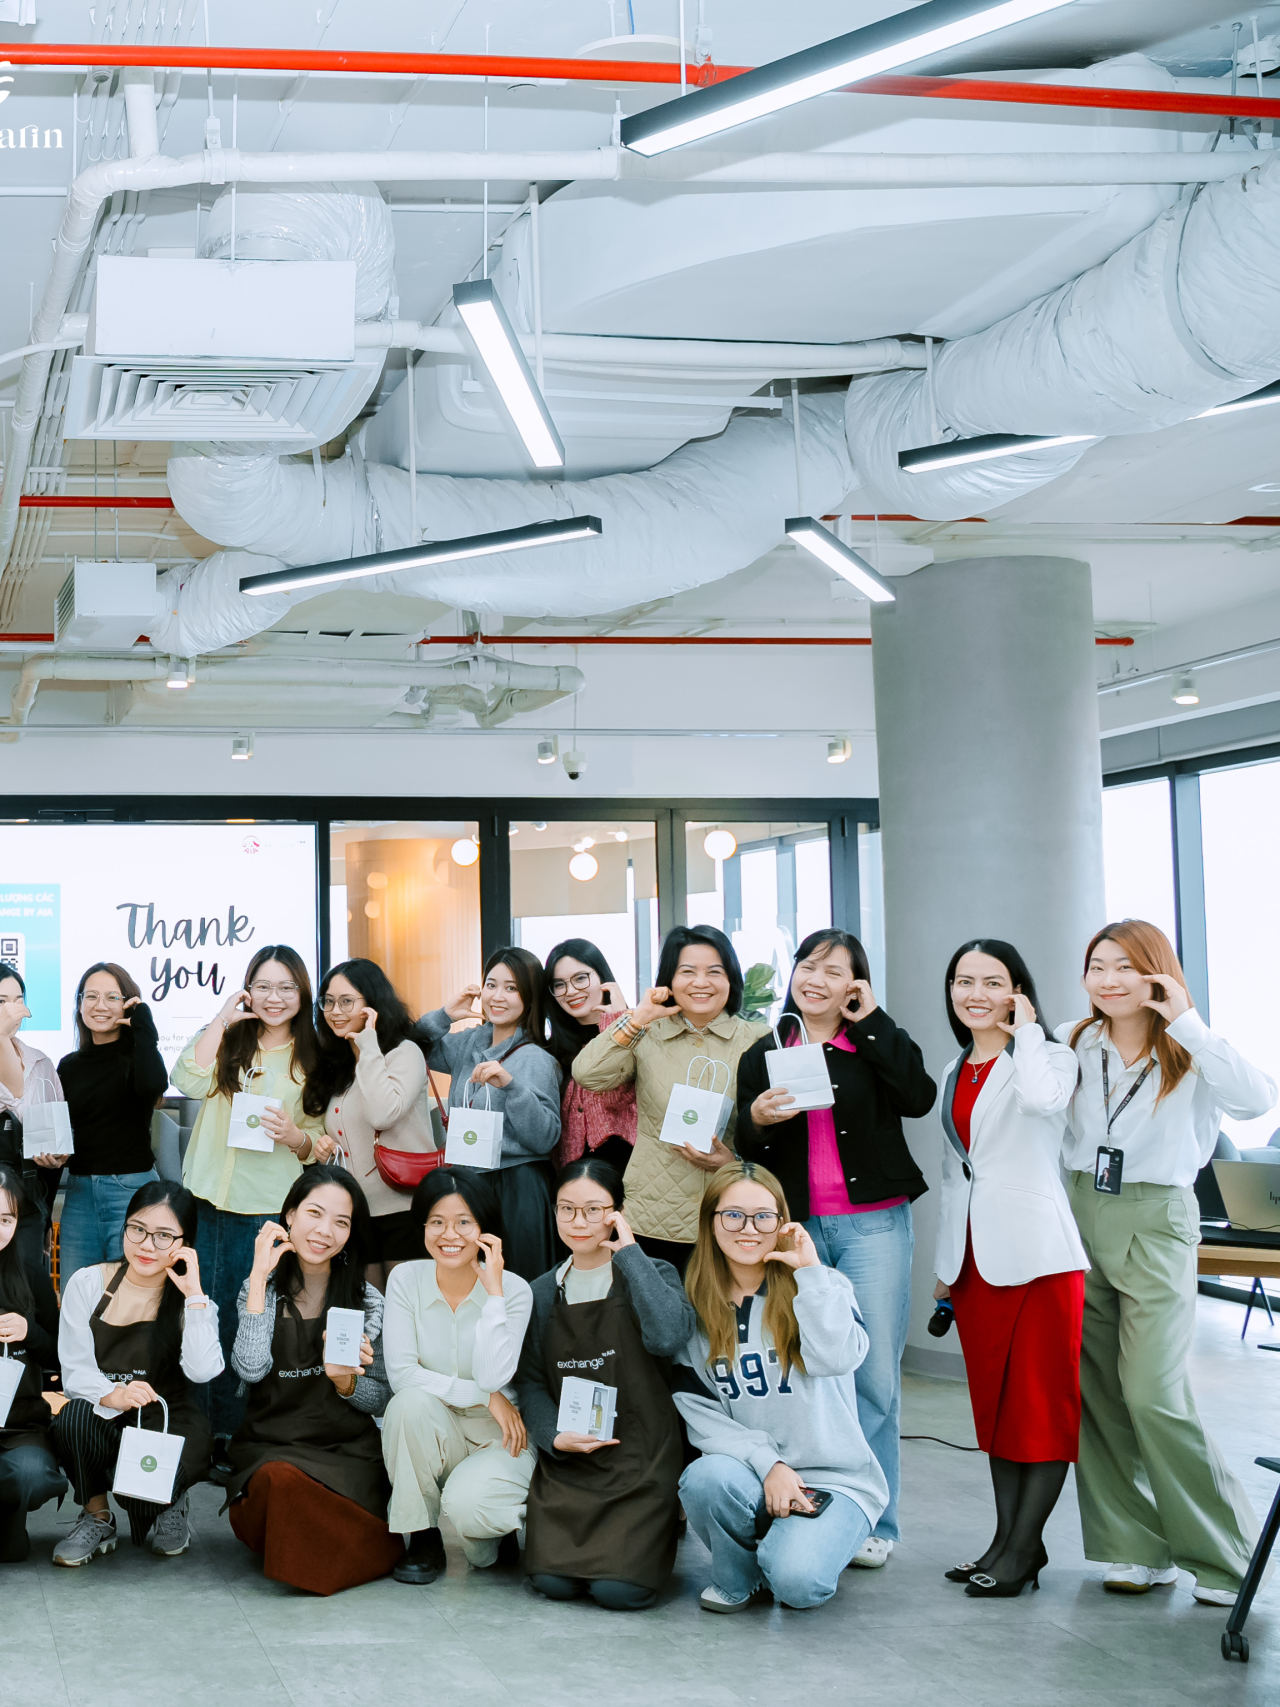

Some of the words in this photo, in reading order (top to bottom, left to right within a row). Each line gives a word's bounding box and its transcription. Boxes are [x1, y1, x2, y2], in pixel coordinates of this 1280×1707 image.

[0, 892, 33, 904] LƯỢNG
[35, 892, 54, 902] CÁC
[23, 908, 35, 917] BY
[36, 908, 53, 917] AIA
[116, 902, 255, 950] Thank
[150, 956, 225, 1002] you
[173, 1033, 184, 1041] for
[557, 1358, 604, 1369] exchange
[279, 1365, 325, 1378] exchange
